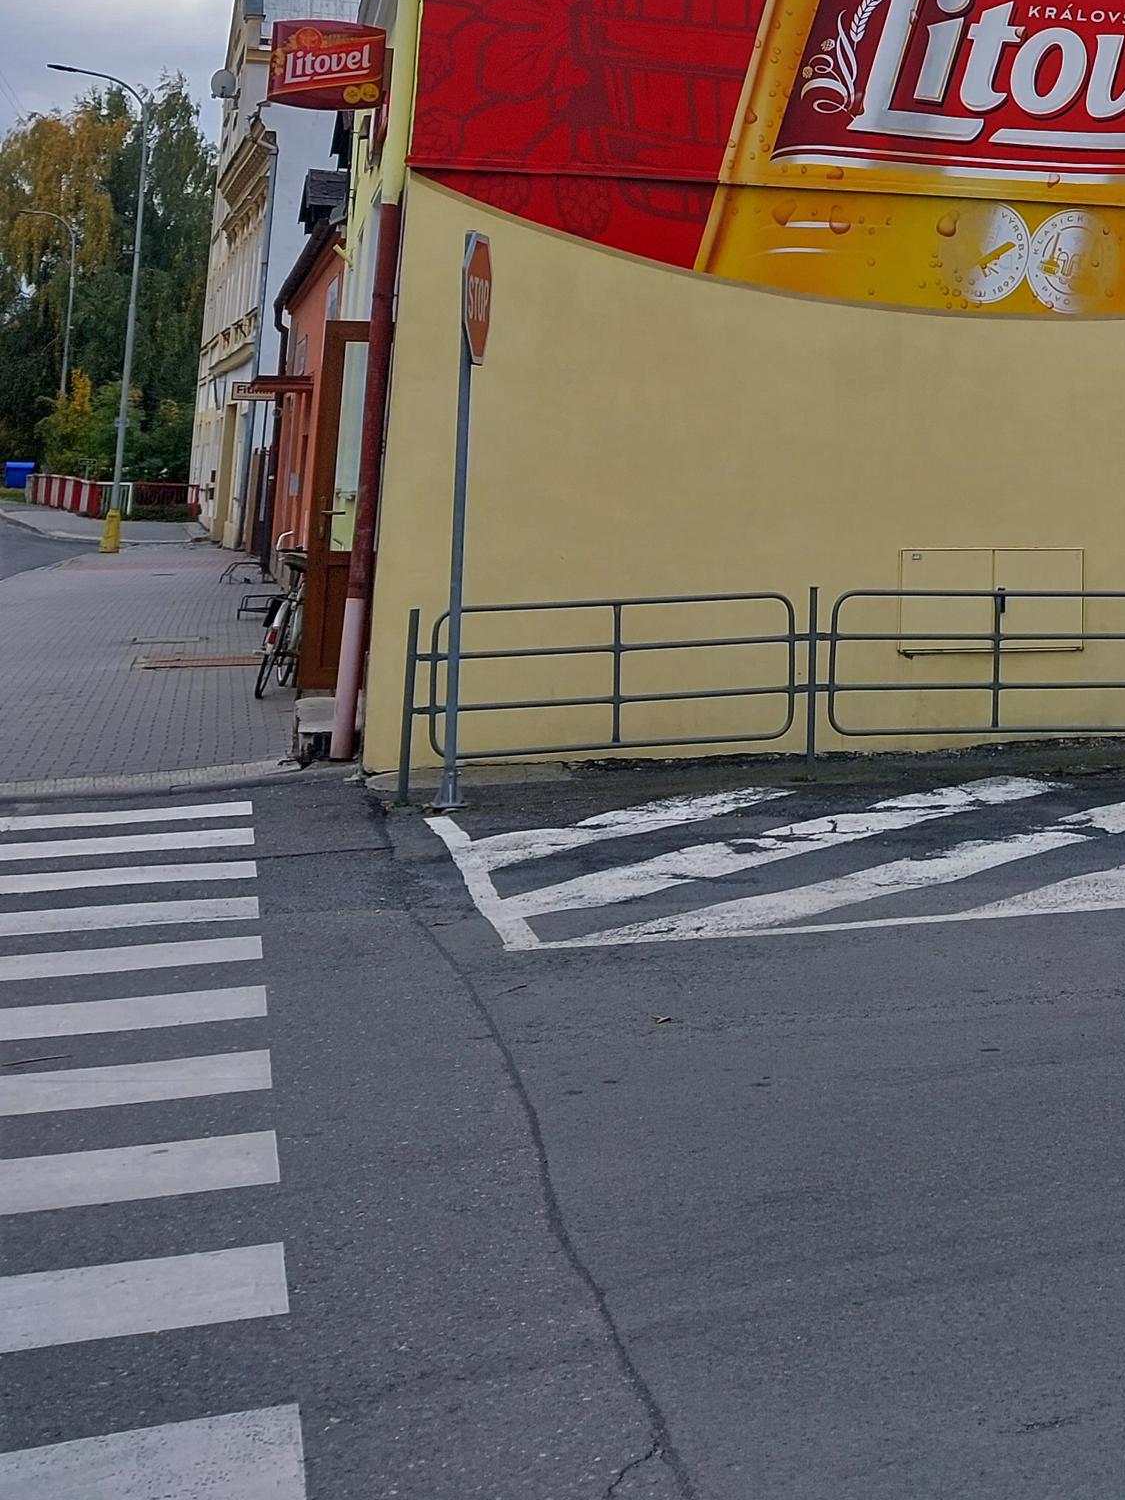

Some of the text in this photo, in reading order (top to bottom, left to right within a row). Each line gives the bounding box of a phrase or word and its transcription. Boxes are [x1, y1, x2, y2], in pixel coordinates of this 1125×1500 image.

[284, 43, 372, 85] Litovel
[1001, 211, 1025, 261] VÝROBA
[1033, 215, 1087, 255] KLASICK
[468, 275, 490, 322] STOP
[1041, 285, 1071, 306] PIVO
